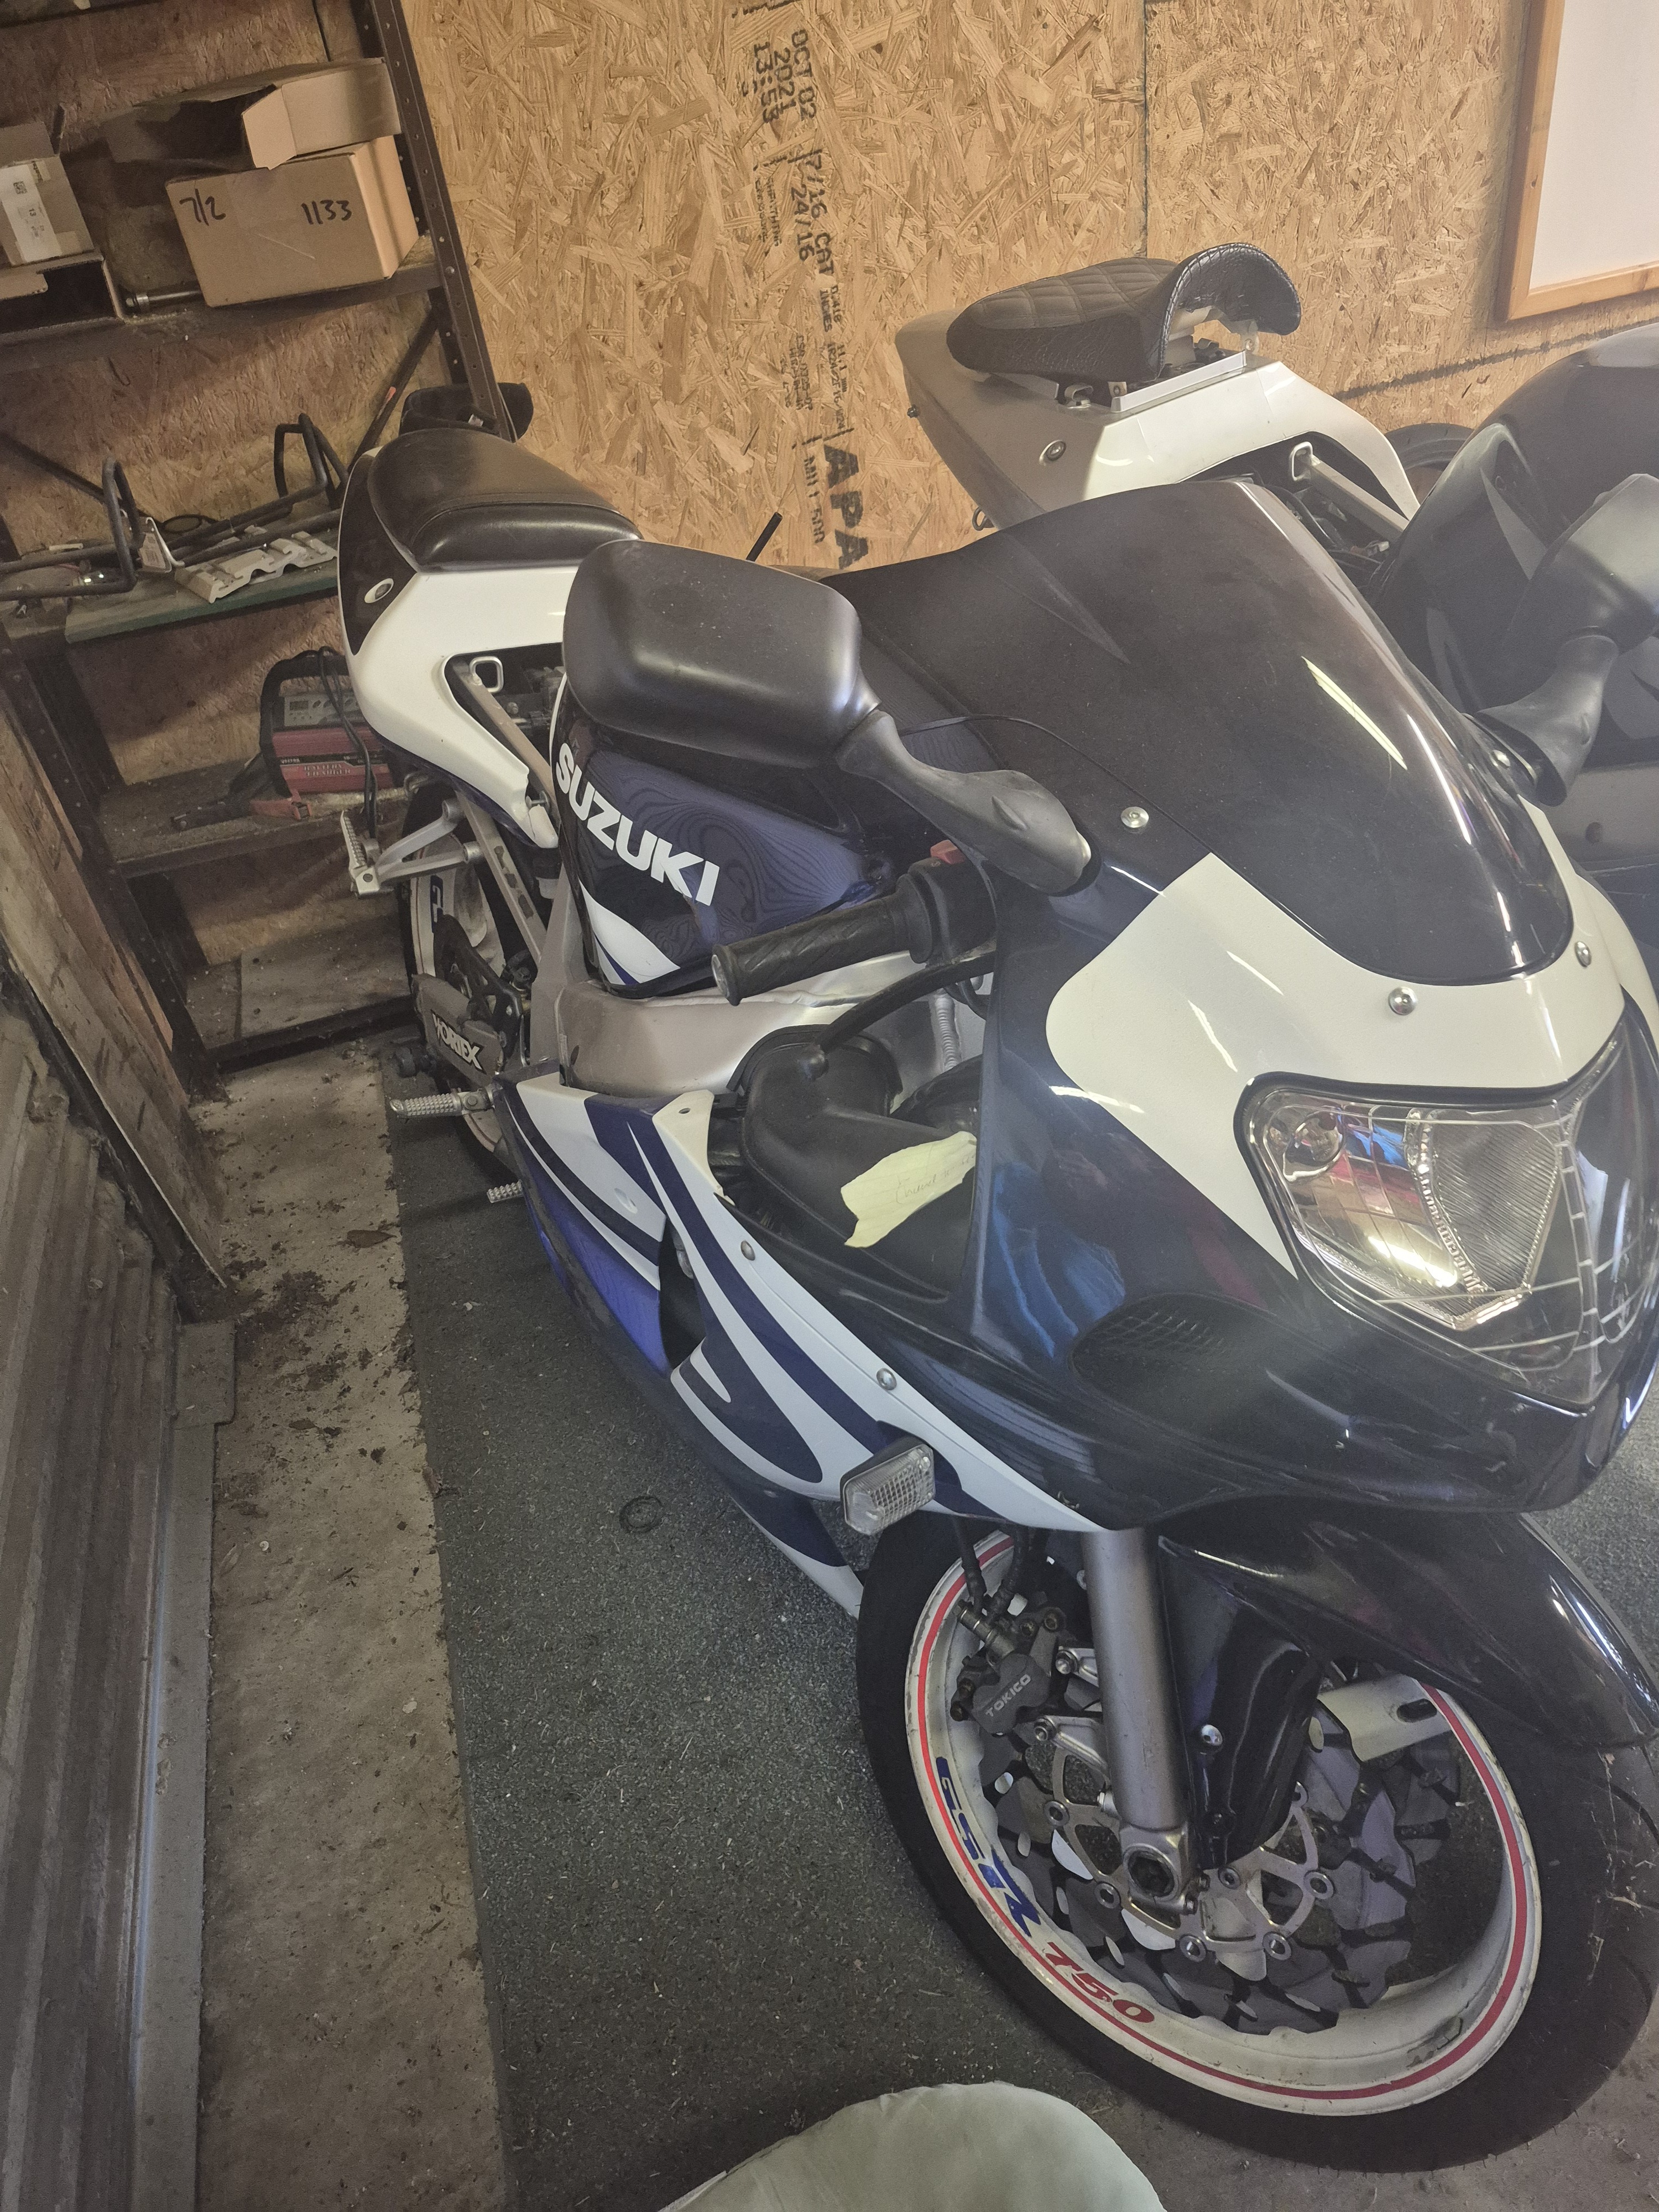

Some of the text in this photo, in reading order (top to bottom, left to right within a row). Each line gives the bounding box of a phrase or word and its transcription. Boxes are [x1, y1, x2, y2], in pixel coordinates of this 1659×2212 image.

[753, 41, 775, 123] 13:53
[774, 49, 796, 115] 2021
[791, 29, 817, 121] OCT 02
[301, 200, 352, 225] 1133
[791, 184, 815, 262] 24/16
[805, 154, 834, 274] 7/16 CAT
[824, 445, 869, 570] APA
[556, 743, 720, 906] SUZUKI
[432, 1011, 483, 1071] VORTEX
[985, 1673, 1031, 1718] TOKICO
[1044, 1942, 1155, 2024] 750
